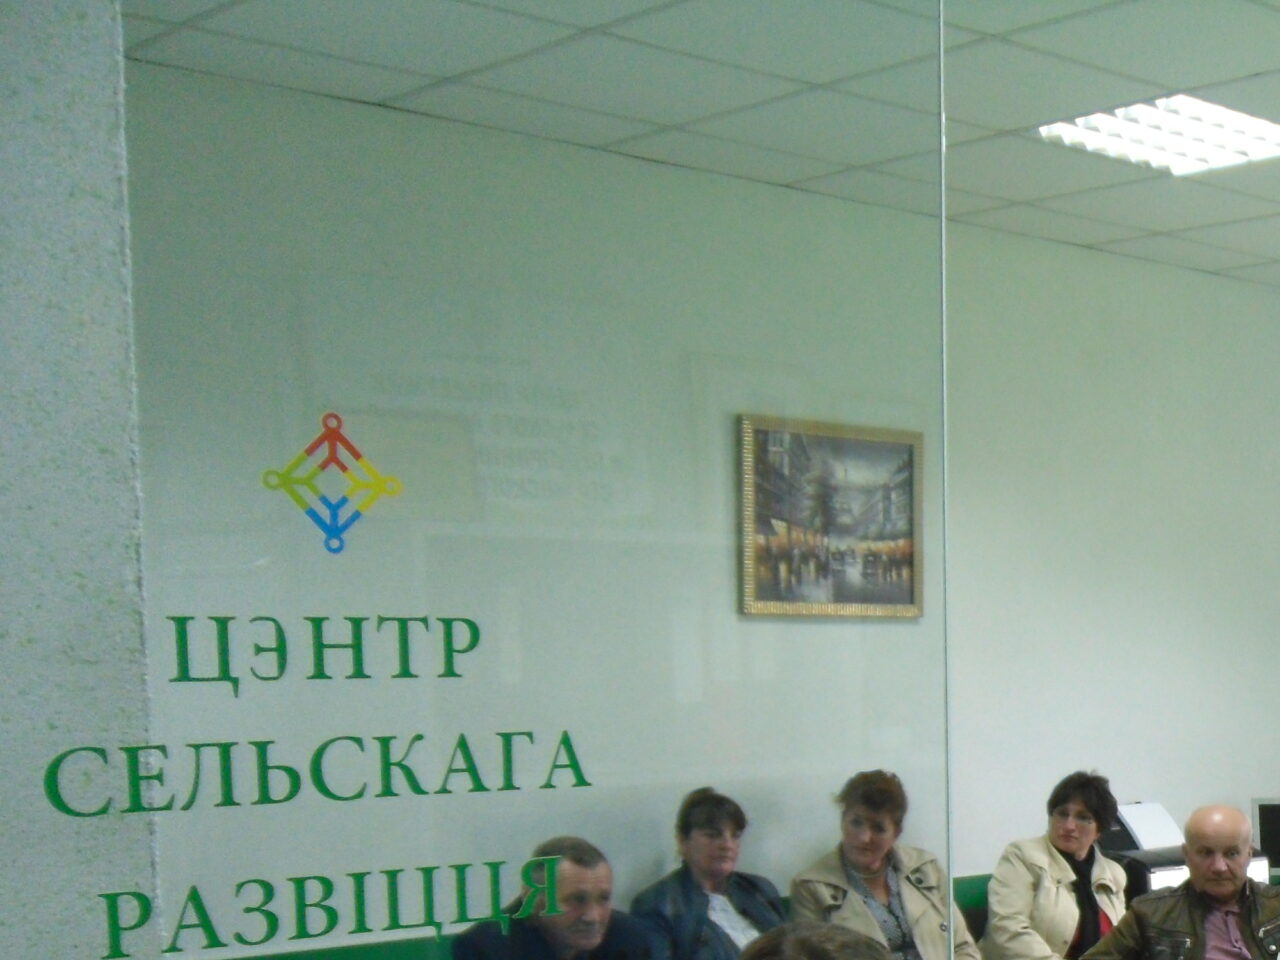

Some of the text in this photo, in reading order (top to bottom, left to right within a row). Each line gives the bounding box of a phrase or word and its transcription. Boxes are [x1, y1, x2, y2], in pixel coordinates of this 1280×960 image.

[166, 614, 481, 698] ЦЭНТР
[43, 730, 592, 818] СЕЛЬСКАГА
[97, 855, 566, 960] РАЗВІЦЦЯ
